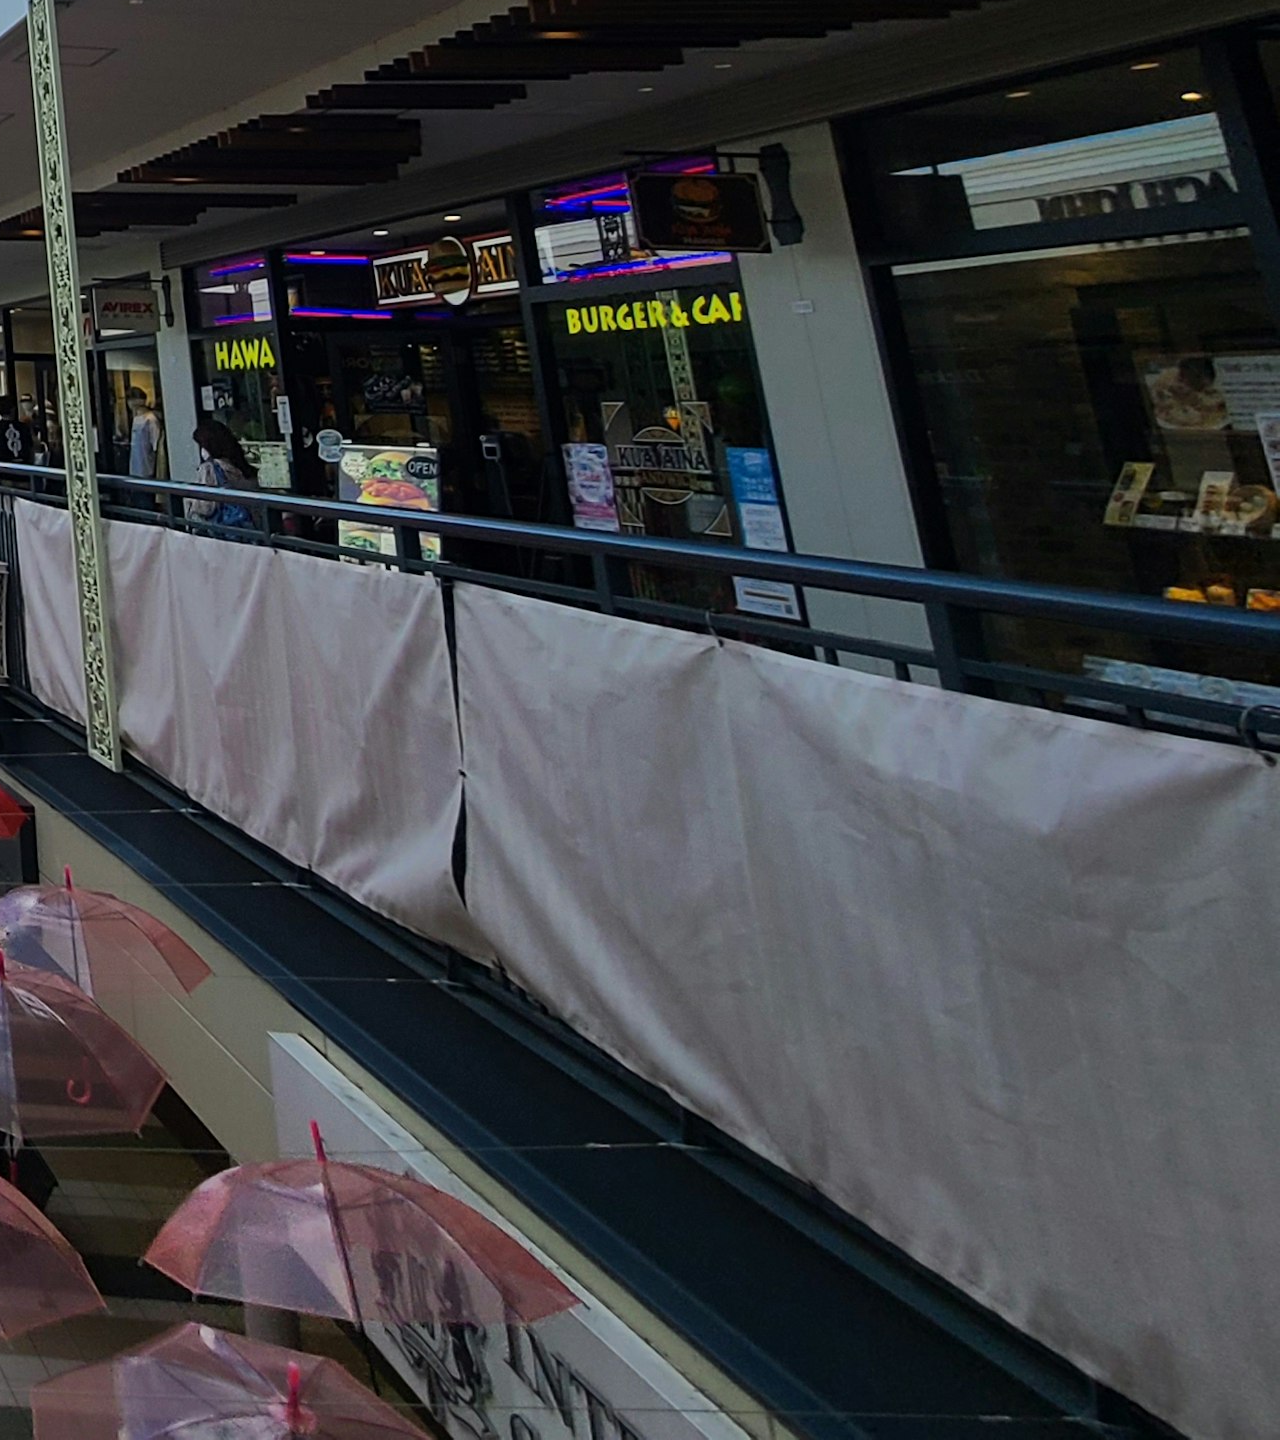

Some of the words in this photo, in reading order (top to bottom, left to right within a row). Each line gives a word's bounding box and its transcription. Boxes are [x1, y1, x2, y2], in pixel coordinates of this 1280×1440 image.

[377, 261, 430, 299] KUA
[102, 302, 154, 314] AVIREX
[566, 300, 667, 334] BURGER
[670, 300, 689, 327] &
[215, 337, 275, 371] HAWA
[407, 461, 438, 475] OPEN
